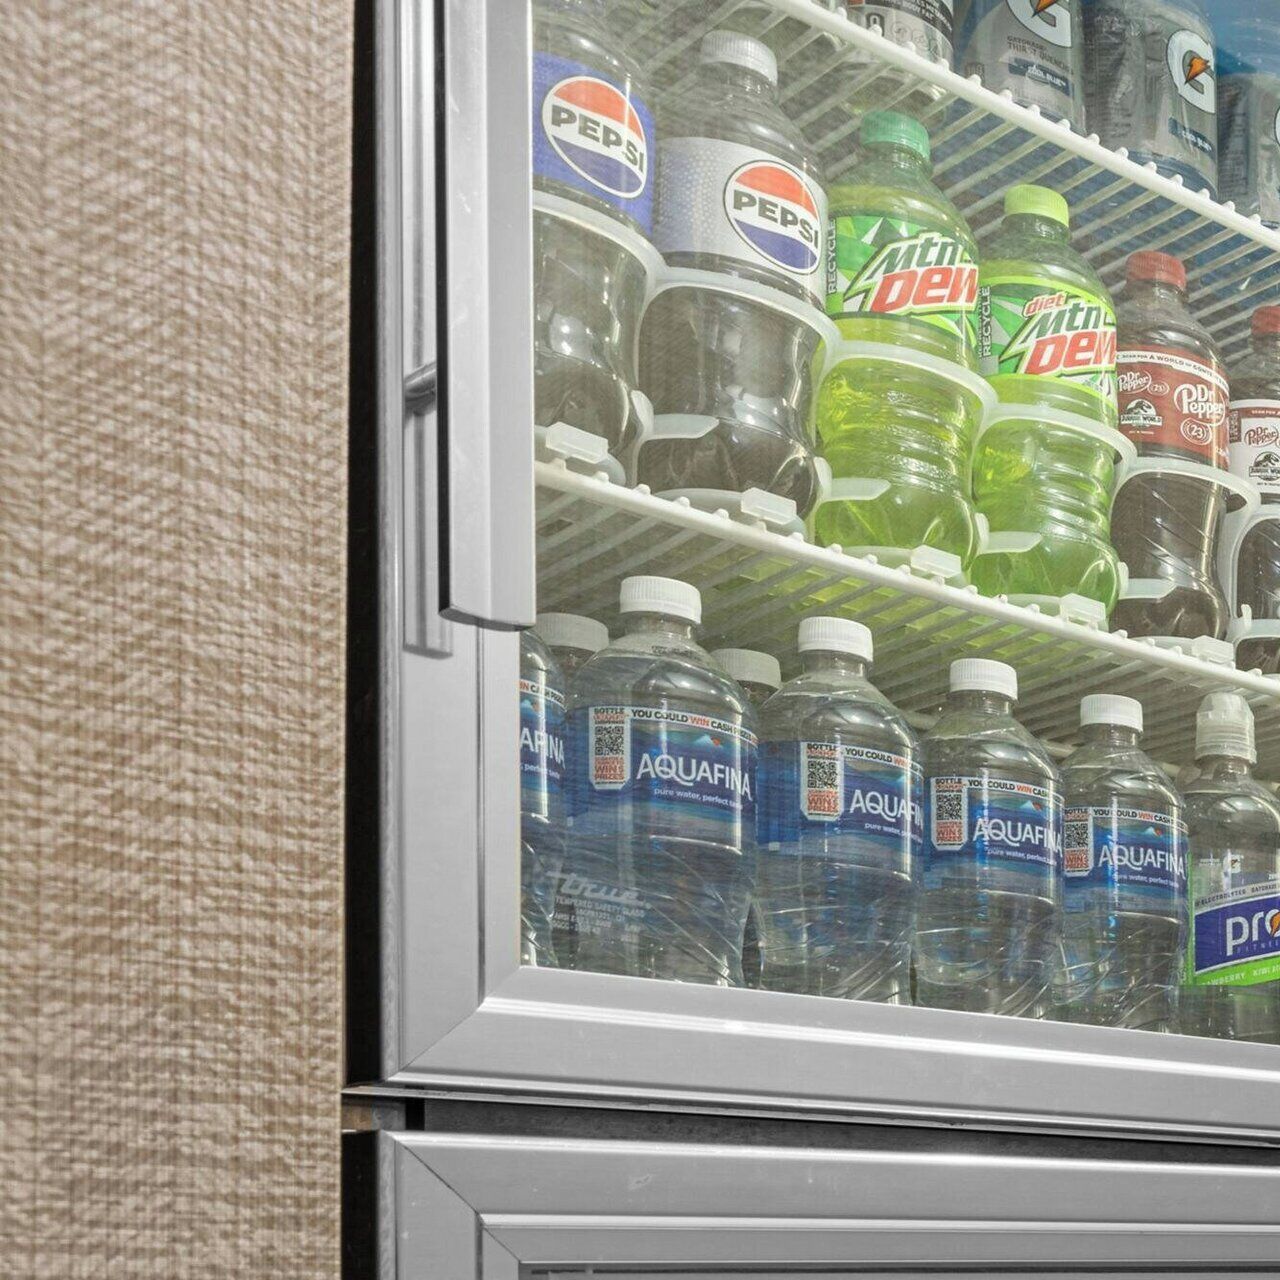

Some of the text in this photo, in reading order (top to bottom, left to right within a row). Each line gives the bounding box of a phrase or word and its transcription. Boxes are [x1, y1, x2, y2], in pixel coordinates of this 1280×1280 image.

[551, 103, 645, 174] PEPSI
[733, 192, 819, 249] PEPSI
[1026, 291, 1067, 316] diet
[982, 285, 992, 358] RECYCLE
[1191, 425, 1204, 438] 23
[631, 709, 732, 733] YOU COULD WIN CASH
[845, 747, 864, 757] YOU
[865, 750, 893, 762] COULD
[636, 753, 753, 802] AQUAFINA
[987, 780, 1016, 791] COULD
[1016, 784, 1033, 793] WIN
[654, 788, 674, 796] pure
[676, 791, 702, 801] water,
[1093, 808, 1110, 816] YOU
[1138, 811, 1154, 821] WIN
[973, 818, 1063, 858] AQUAFINA
[1098, 844, 1186, 880] AQUAFINA
